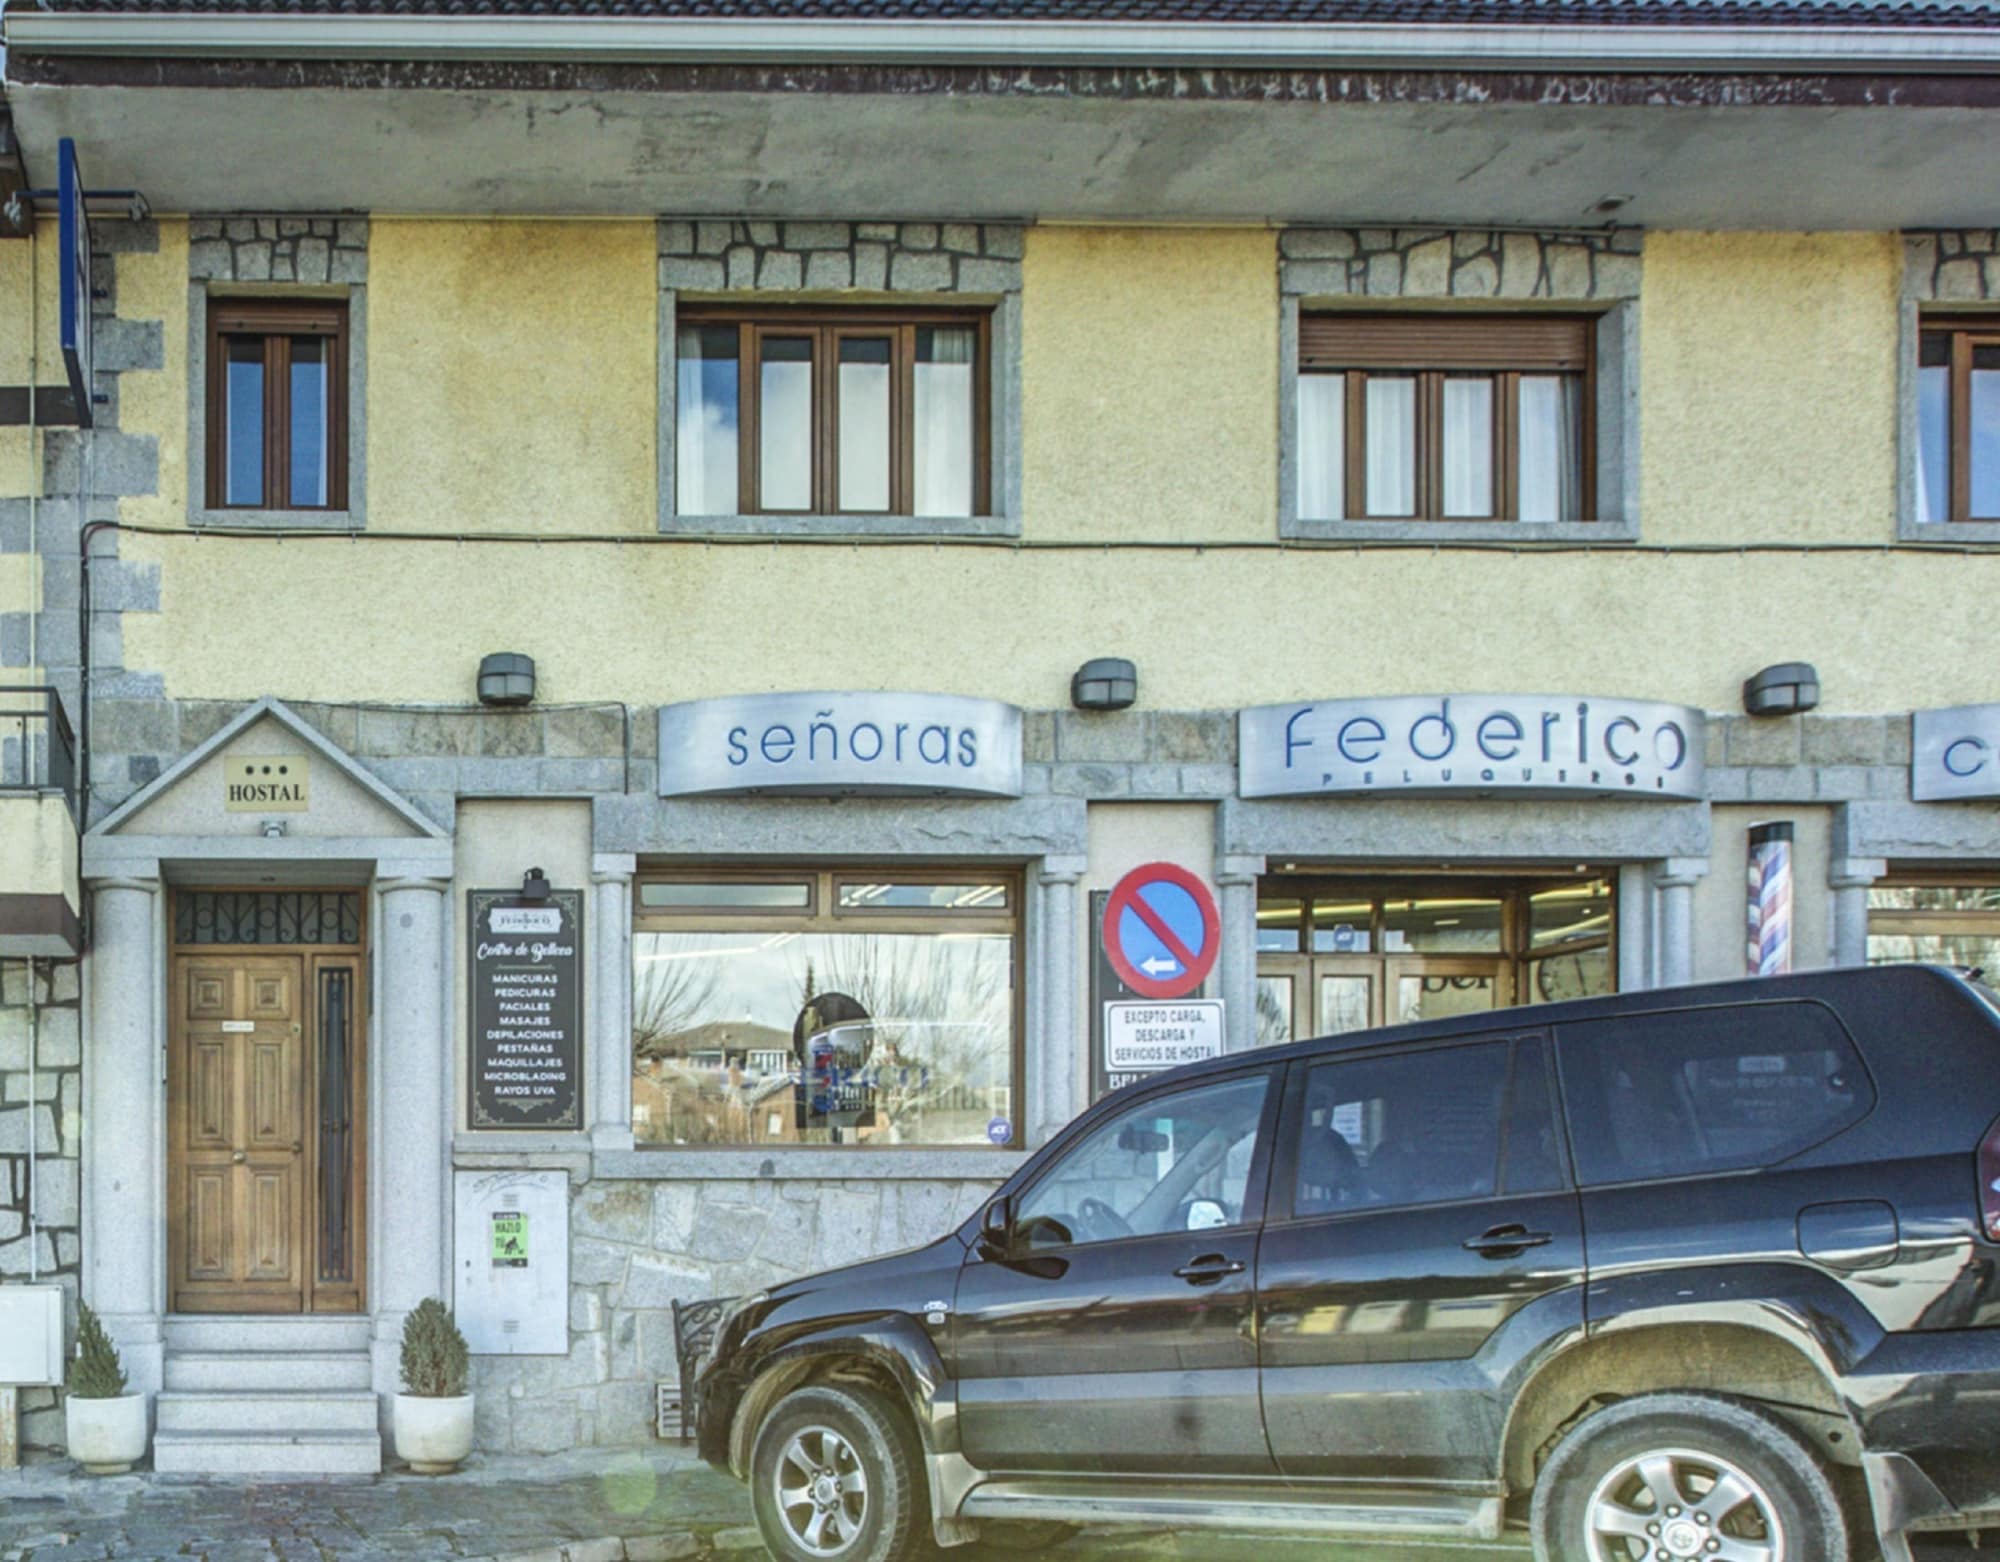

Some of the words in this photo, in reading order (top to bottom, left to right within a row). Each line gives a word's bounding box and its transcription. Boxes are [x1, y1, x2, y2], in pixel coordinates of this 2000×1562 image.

[726, 709, 978, 768] señoras
[1285, 698, 1687, 771] federico
[1943, 736, 1990, 777] c
[229, 784, 305, 802] HOSTAL
[514, 941, 529, 957] de
[492, 974, 558, 984] MANICURAS
[494, 988, 556, 998] PEDICURAS
[499, 1002, 551, 1012] FACIALES
[499, 1016, 551, 1026] MASAJES
[1125, 1010, 1167, 1024] EXCEPTO
[486, 1029, 564, 1040] DEPILACIONES
[1135, 1028, 1187, 1042] DESCARGA
[1189, 1028, 1196, 1041] Y
[496, 1043, 554, 1054] PESTAÑAS
[1114, 1047, 1163, 1061] SERVICIOS
[1165, 1046, 1178, 1060] DE
[487, 1058, 563, 1068] MAQUILLAJES
[483, 1071, 567, 1082] MICROBLADING
[494, 1086, 531, 1096] RAYOS
[533, 1086, 557, 1096] UVA
